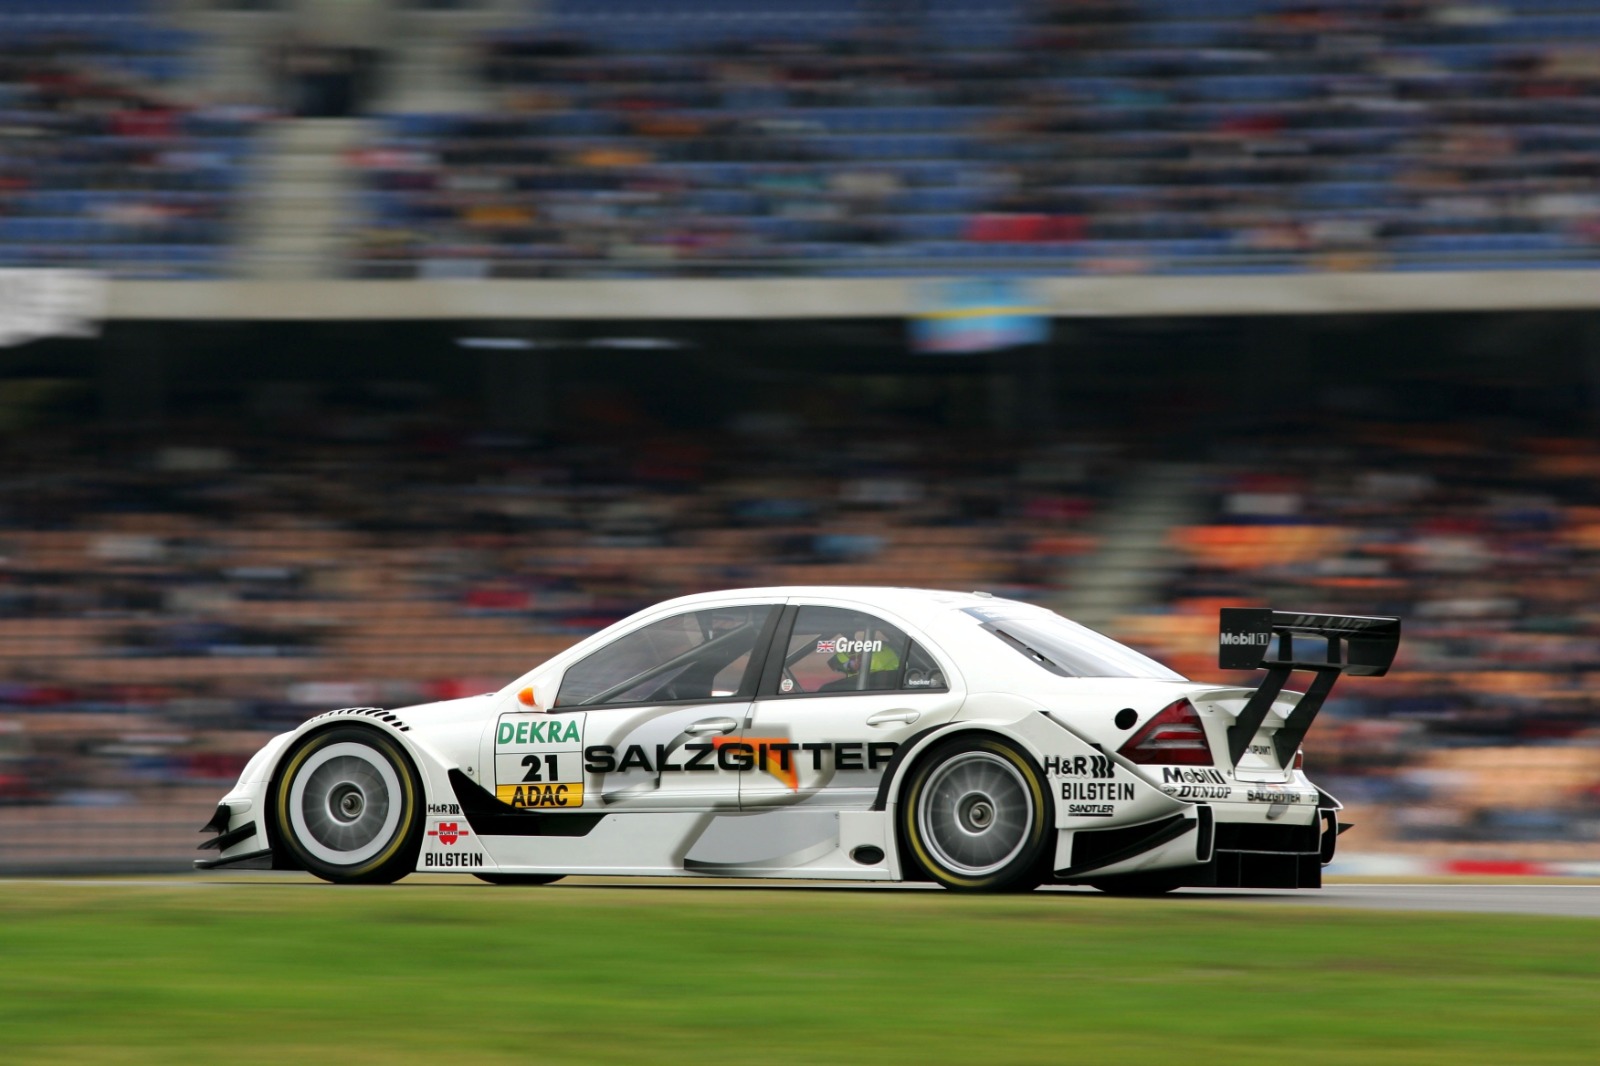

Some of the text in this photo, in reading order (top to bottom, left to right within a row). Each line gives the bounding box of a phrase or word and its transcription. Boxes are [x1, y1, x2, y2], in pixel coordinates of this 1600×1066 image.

[835, 637, 882, 652] Green
[1220, 633, 1268, 646] Mobil 1
[498, 720, 580, 744] DEKRA
[521, 755, 558, 782] 21
[1044, 756, 1087, 775] H&R
[1163, 767, 1213, 783] Mobil
[511, 785, 568, 806] ADAC
[1062, 783, 1134, 800] BILSTEIN
[1178, 786, 1231, 798] DUNLOP
[428, 804, 447, 813] H&R
[1068, 805, 1114, 813] SANDTLER
[425, 853, 482, 866] BILSTEIN
